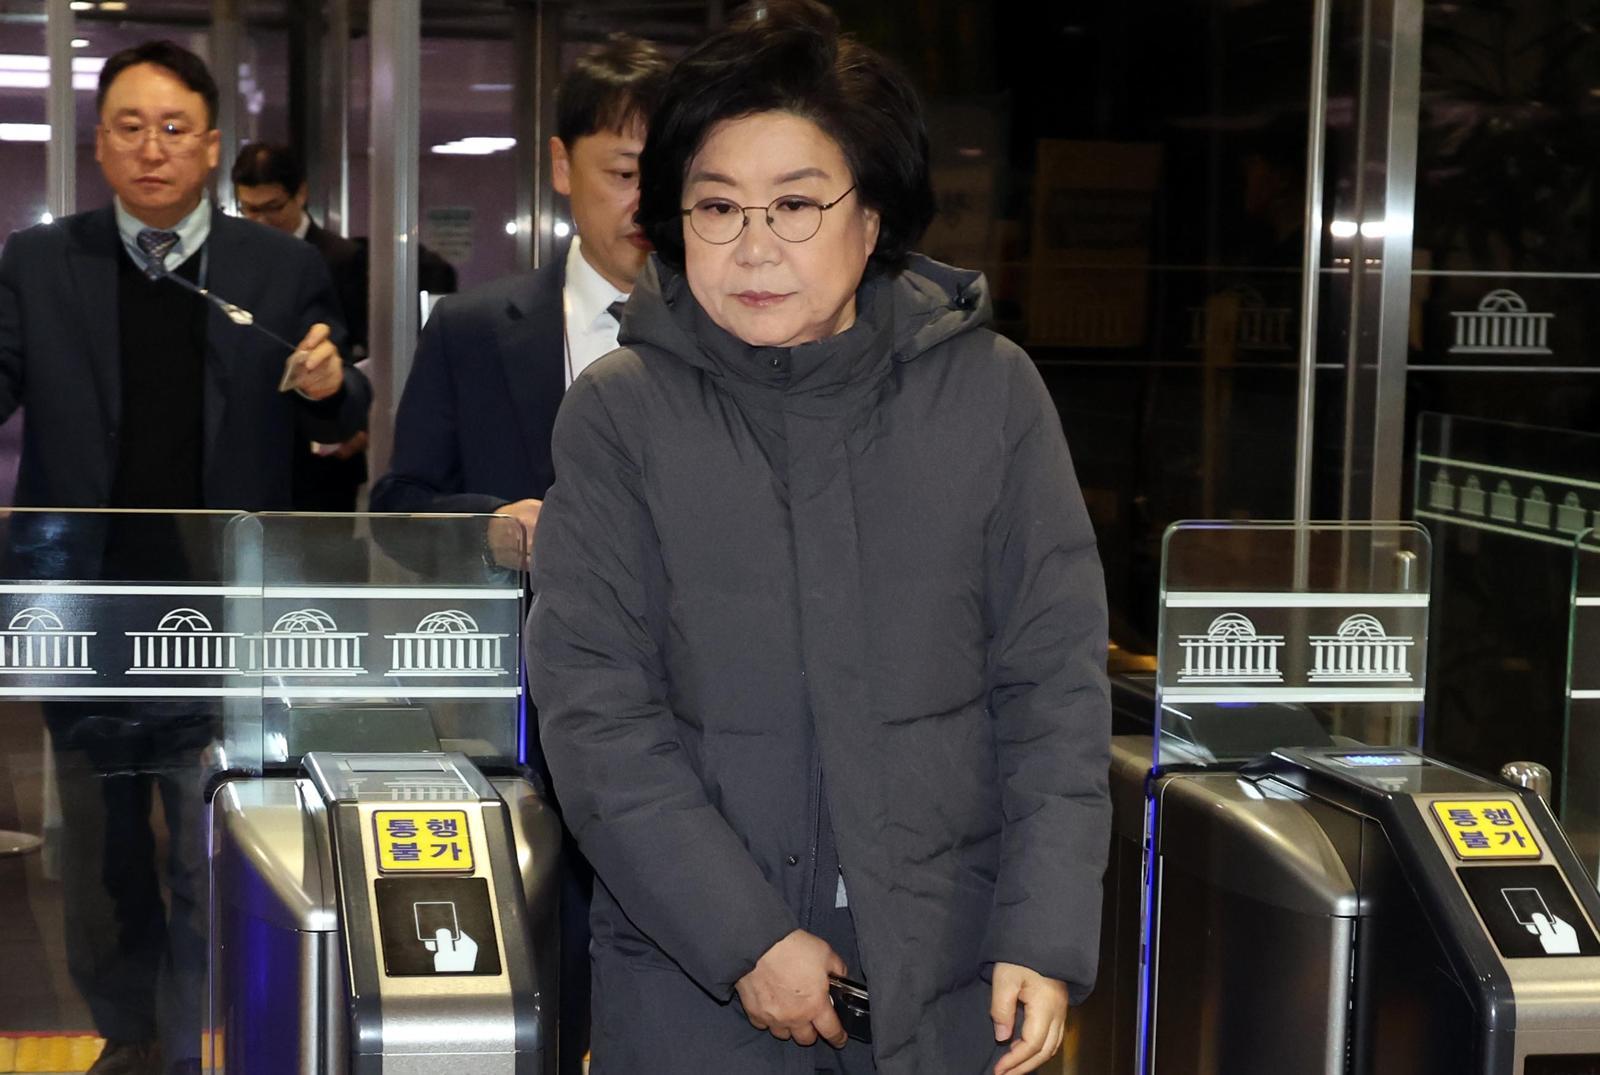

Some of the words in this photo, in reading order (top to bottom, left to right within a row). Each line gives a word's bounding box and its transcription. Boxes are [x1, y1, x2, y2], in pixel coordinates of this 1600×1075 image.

[1448, 808, 1514, 826] 통행
[386, 819, 458, 838] 통행
[1459, 830, 1526, 849] 불가
[388, 842, 463, 861] 불가
